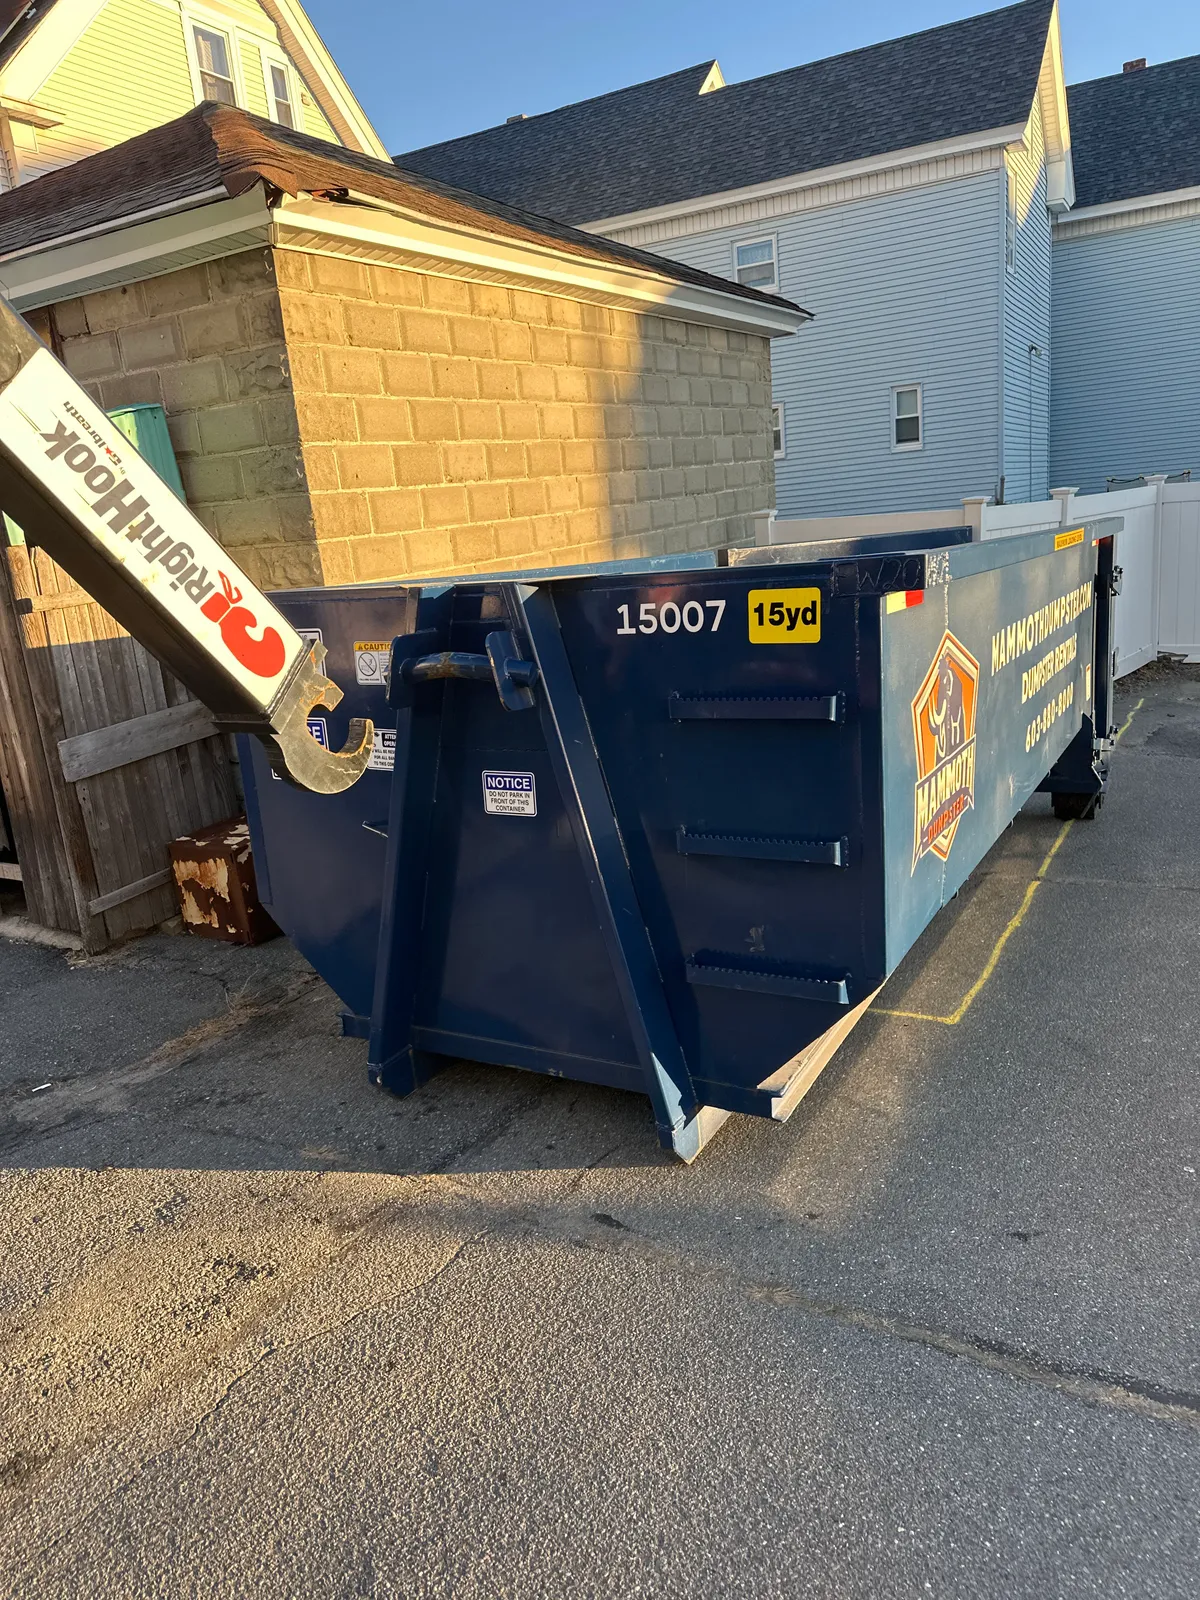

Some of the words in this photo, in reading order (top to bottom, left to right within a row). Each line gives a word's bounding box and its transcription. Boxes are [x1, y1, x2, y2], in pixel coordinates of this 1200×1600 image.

[39, 419, 216, 605] RightHook
[616, 600, 726, 635] 15007
[753, 600, 817, 631] 15yd
[1021, 650, 1055, 704] DUMPSTER
[487, 777, 531, 789] NOTICE
[917, 744, 974, 840] MAMMOTH
[928, 794, 965, 844] DUMPSTER
